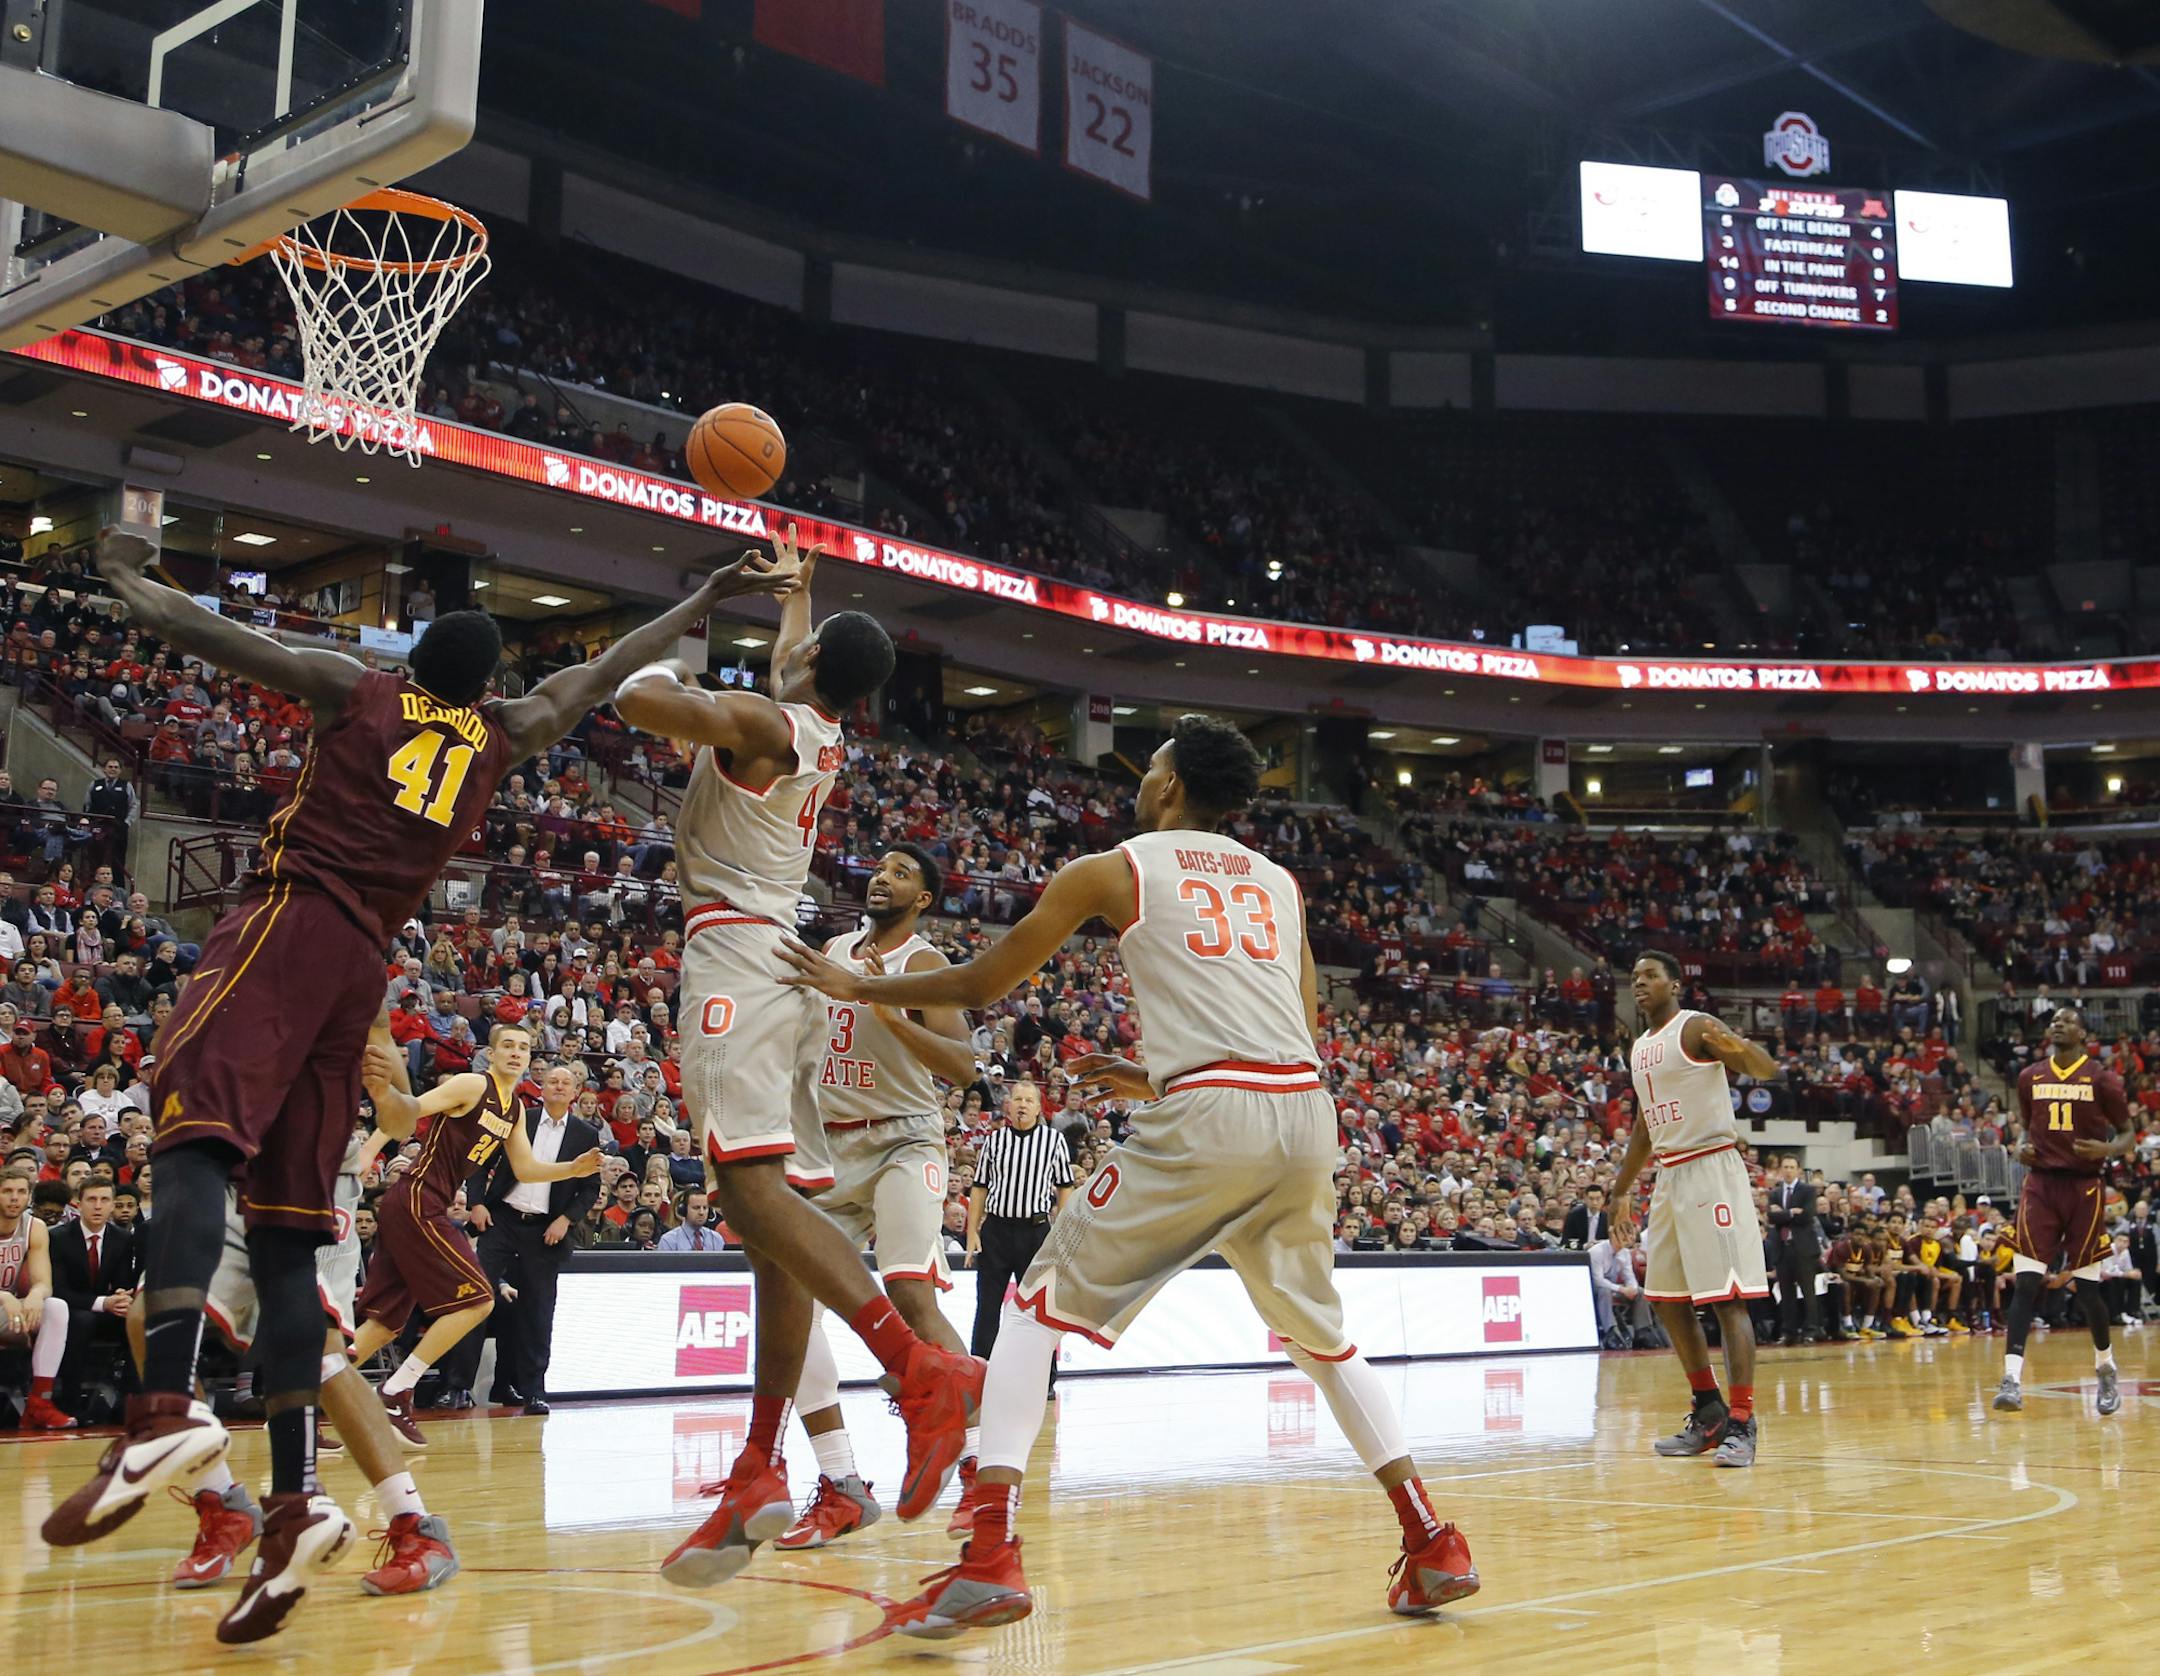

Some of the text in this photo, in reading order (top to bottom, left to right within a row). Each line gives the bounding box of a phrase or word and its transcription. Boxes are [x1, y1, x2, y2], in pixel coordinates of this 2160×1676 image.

[952, 2, 1036, 53] BRADDS
[970, 42, 1018, 103] 35
[1071, 56, 1148, 105] JACKSON
[1086, 94, 1135, 157] 22
[1722, 235, 1734, 249] 3
[1756, 217, 1851, 238] OFF THE BENCH
[1871, 226, 1883, 240] 4
[1719, 255, 1739, 270] 14
[1764, 238, 1845, 258] FASTBREAK
[1764, 259, 1846, 279] IN THE PAINT
[1755, 279, 1858, 300] OFF TURNOVERS
[1873, 288, 1886, 302] 7
[1754, 300, 1861, 322] SECOND CHANCE
[1876, 309, 1888, 323] 2
[579, 466, 768, 537] DONATOS PIZZA
[882, 543, 1038, 604] DONATOS PIZZA
[1113, 603, 1269, 651] DONATOS PIZZA
[1381, 643, 1540, 680] DONATOS PIZZA
[1648, 666, 1823, 690] DONATOS PIZZA
[1936, 668, 2111, 693] DONATOS PIZZA
[387, 729, 476, 828] 41
[796, 783, 816, 848] 4
[1174, 848, 1253, 877] BATES-DIOP
[1177, 877, 1281, 962] 33
[2107, 966, 2126, 978] 111
[1645, 1071, 1656, 1105] 1
[2048, 1101, 2074, 1131] 11
[1483, 1295, 1522, 1323] AEP
[676, 1311, 753, 1350] AEP
